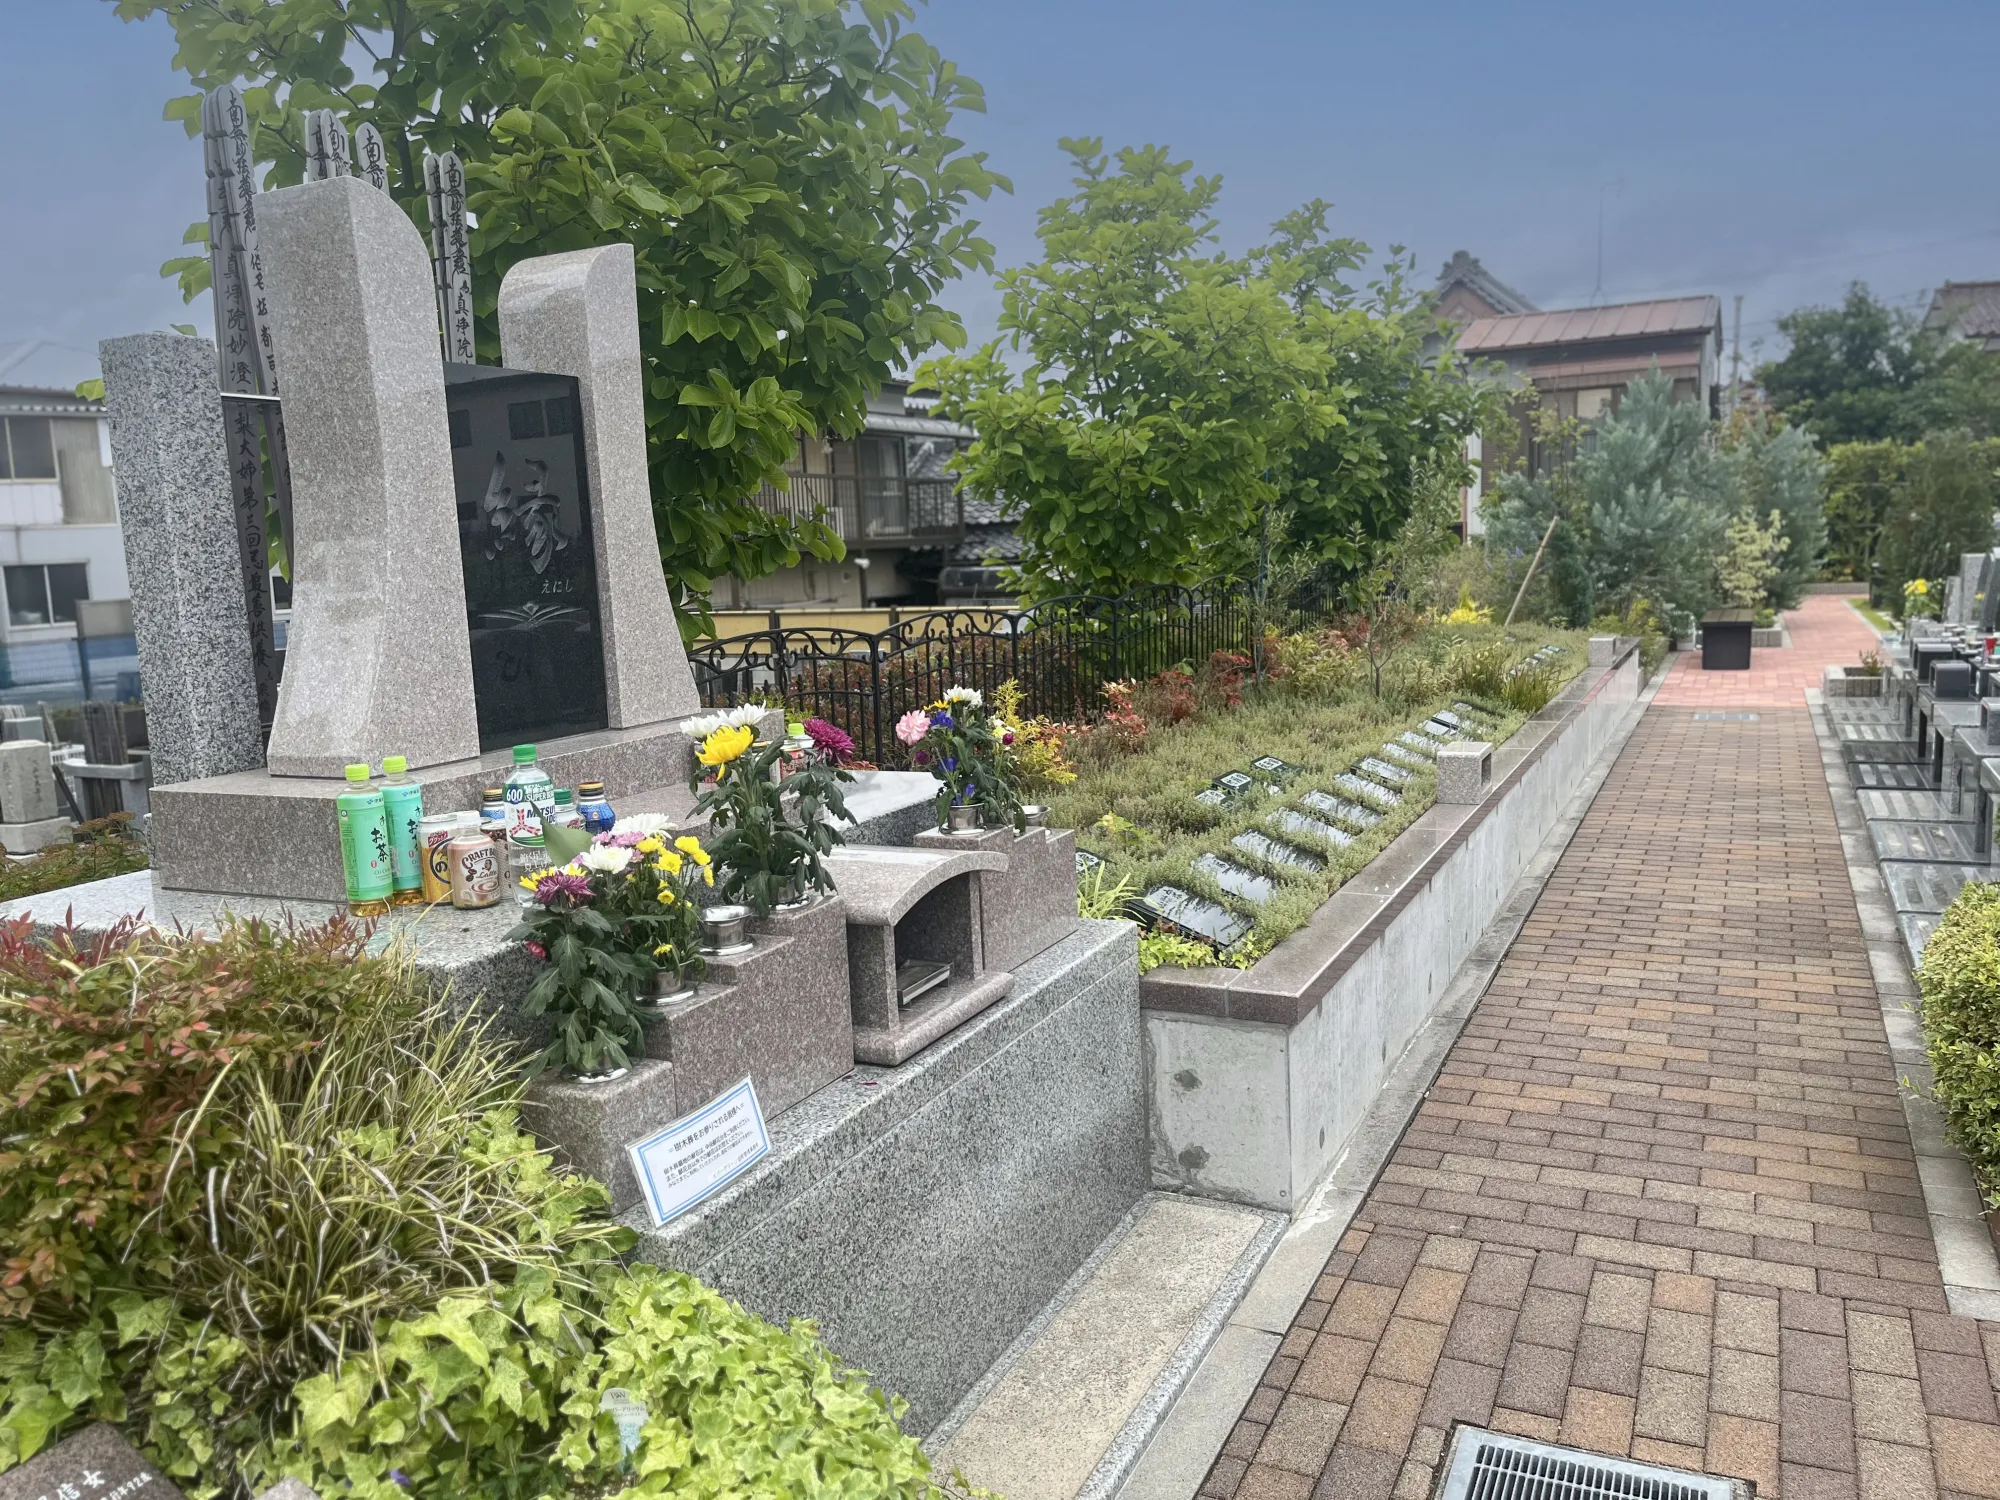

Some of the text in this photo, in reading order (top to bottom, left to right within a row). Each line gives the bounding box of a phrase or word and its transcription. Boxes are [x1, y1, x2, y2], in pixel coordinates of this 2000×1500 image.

[541, 579, 573, 594] えにし
[507, 789, 523, 802] 600
[527, 805, 556, 818] MTSU
[370, 827, 389, 863] お茶
[461, 848, 488, 870] CRAFT
